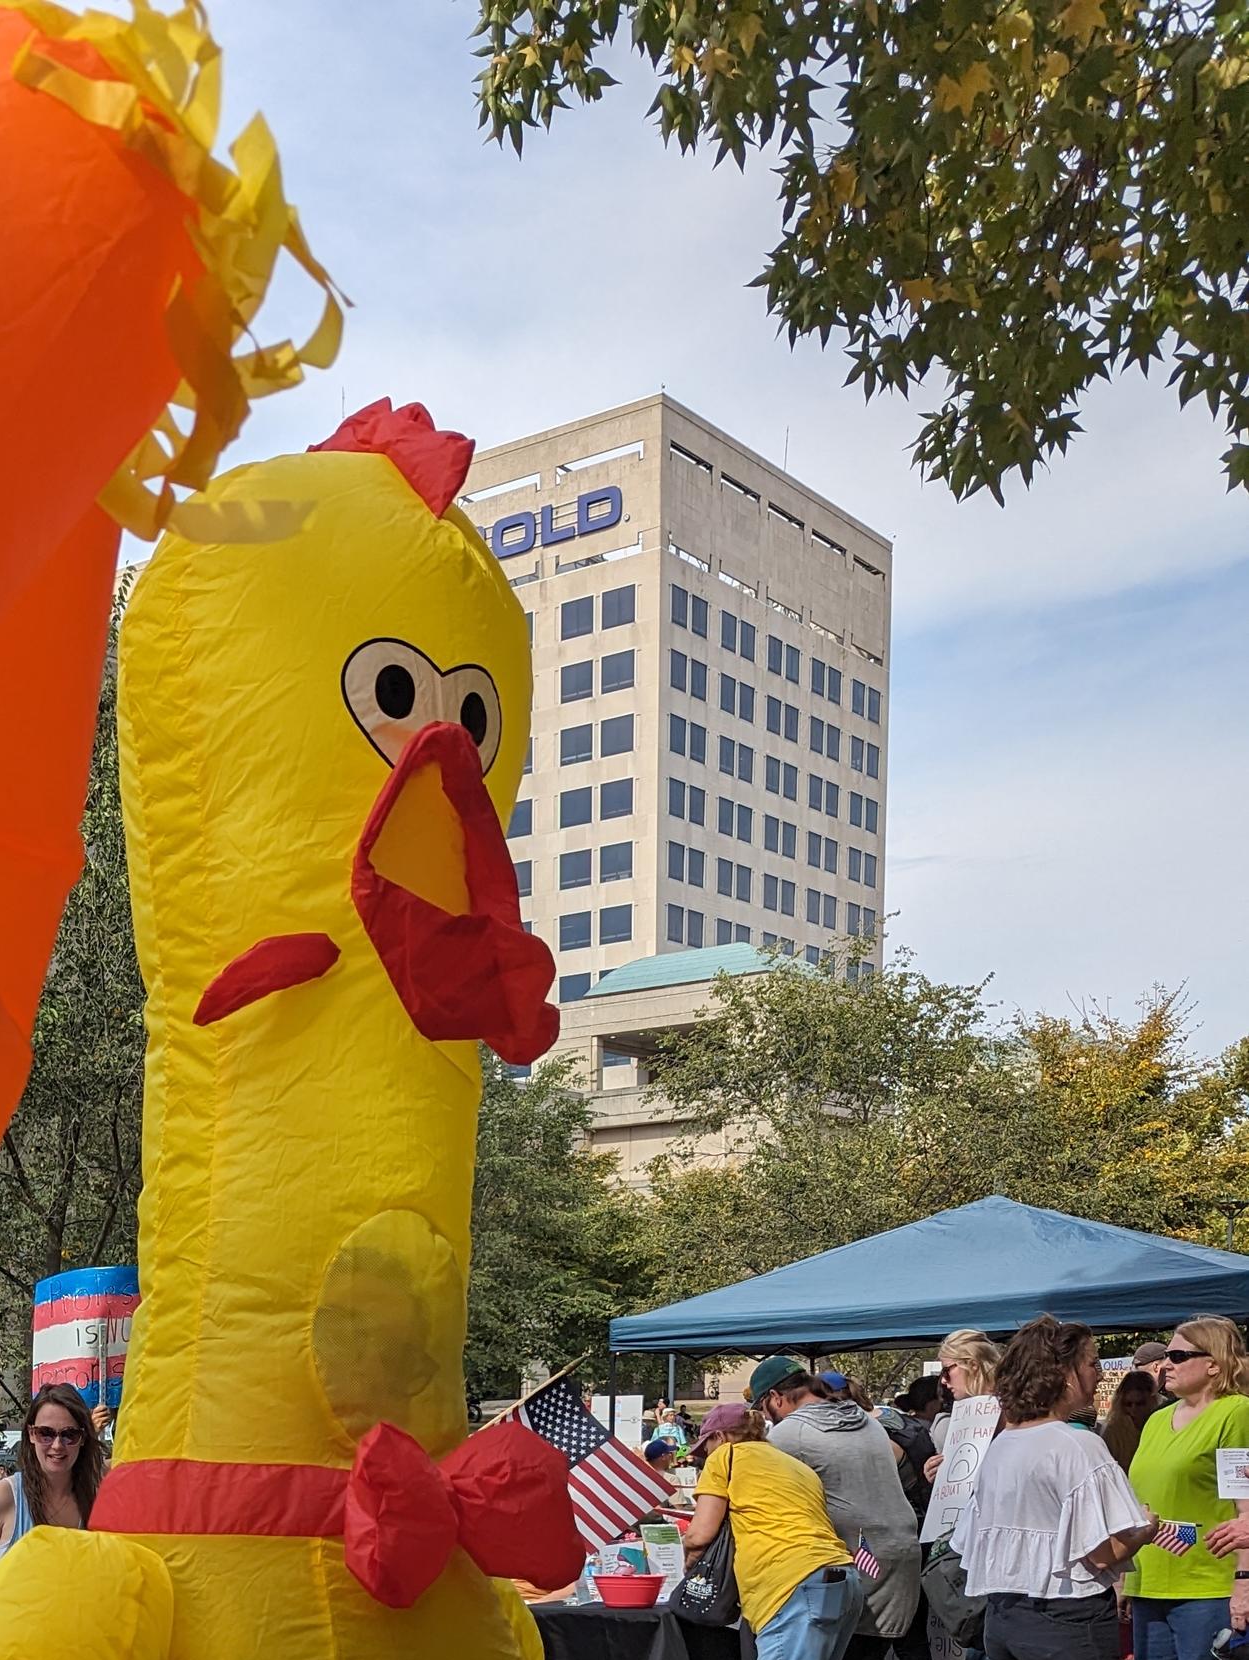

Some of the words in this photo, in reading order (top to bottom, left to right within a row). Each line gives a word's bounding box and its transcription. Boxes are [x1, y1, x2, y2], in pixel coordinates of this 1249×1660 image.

[477, 485, 622, 559] OLD
[975, 1401, 1001, 1417] REA
[950, 1428, 969, 1446] NOT
